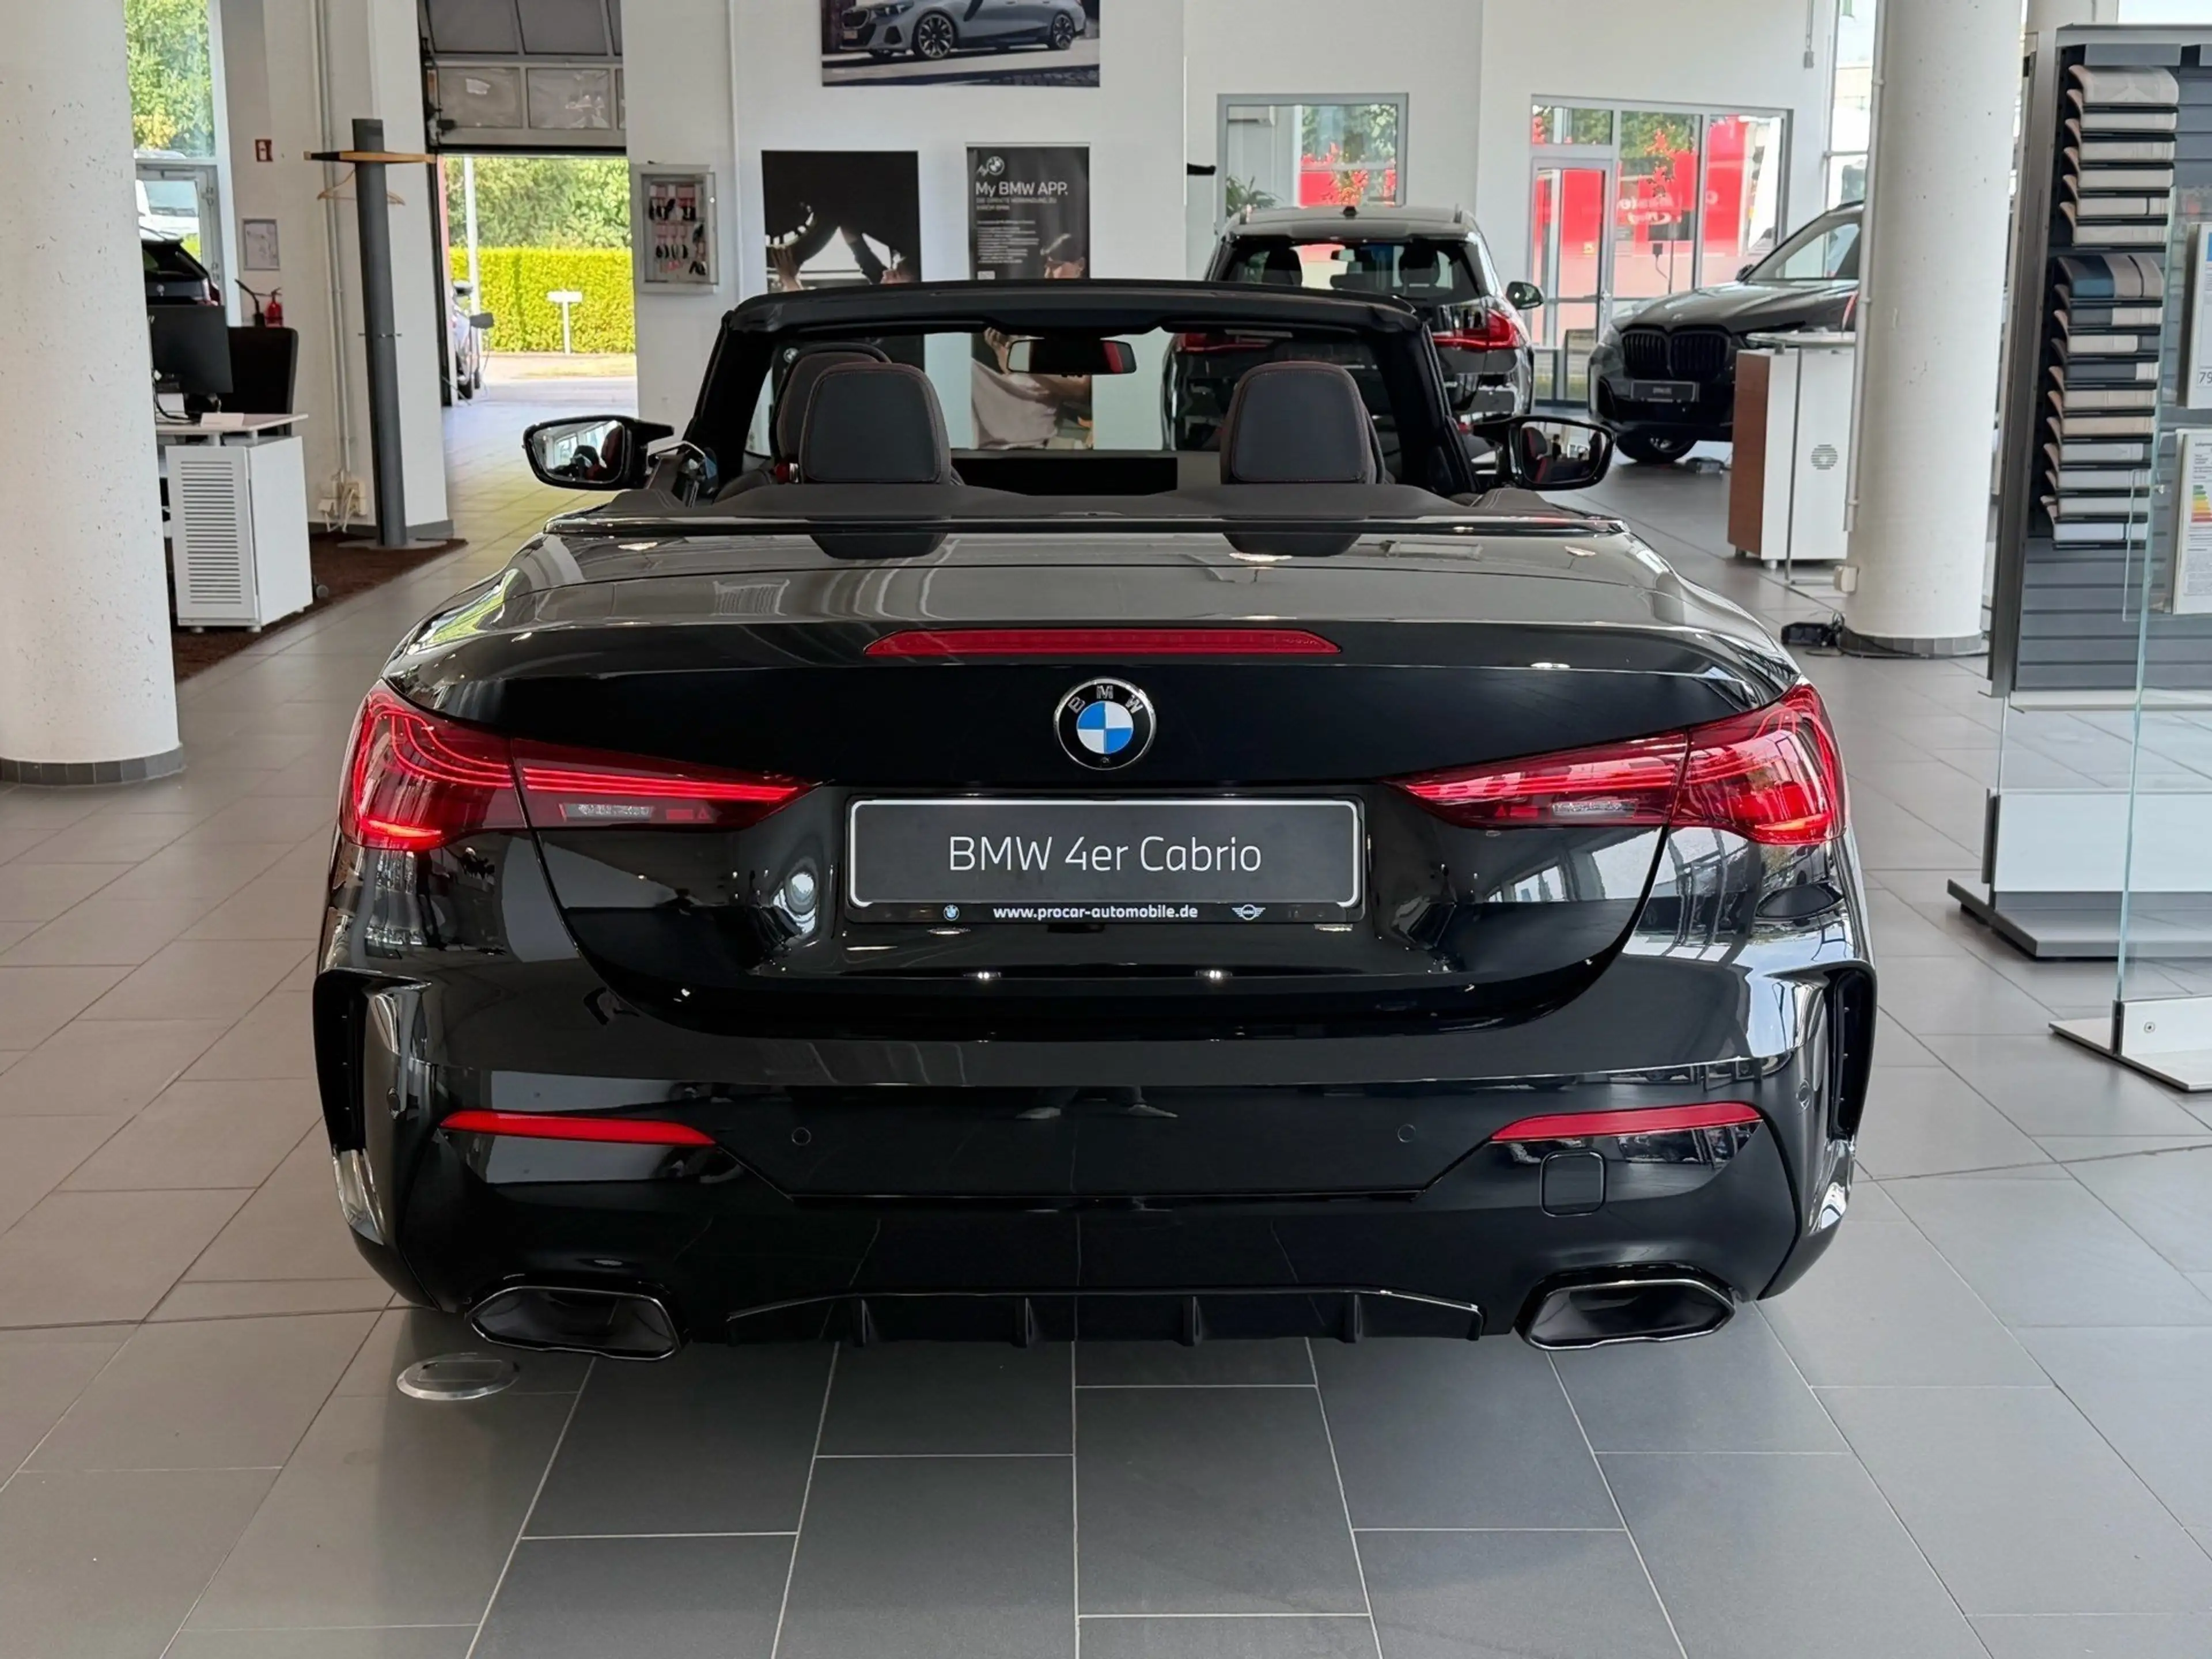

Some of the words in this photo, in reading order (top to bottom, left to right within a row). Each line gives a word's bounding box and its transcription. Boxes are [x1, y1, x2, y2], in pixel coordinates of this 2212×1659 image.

[976, 181, 996, 197] My
[999, 181, 1035, 195] BMW
[1067, 685, 1144, 714] BMW
[950, 836, 1052, 870] BMW
[1065, 836, 1128, 871] 4er
[1141, 836, 1261, 871] Cabrio
[993, 907, 1198, 921] www.procar-automobile.de
